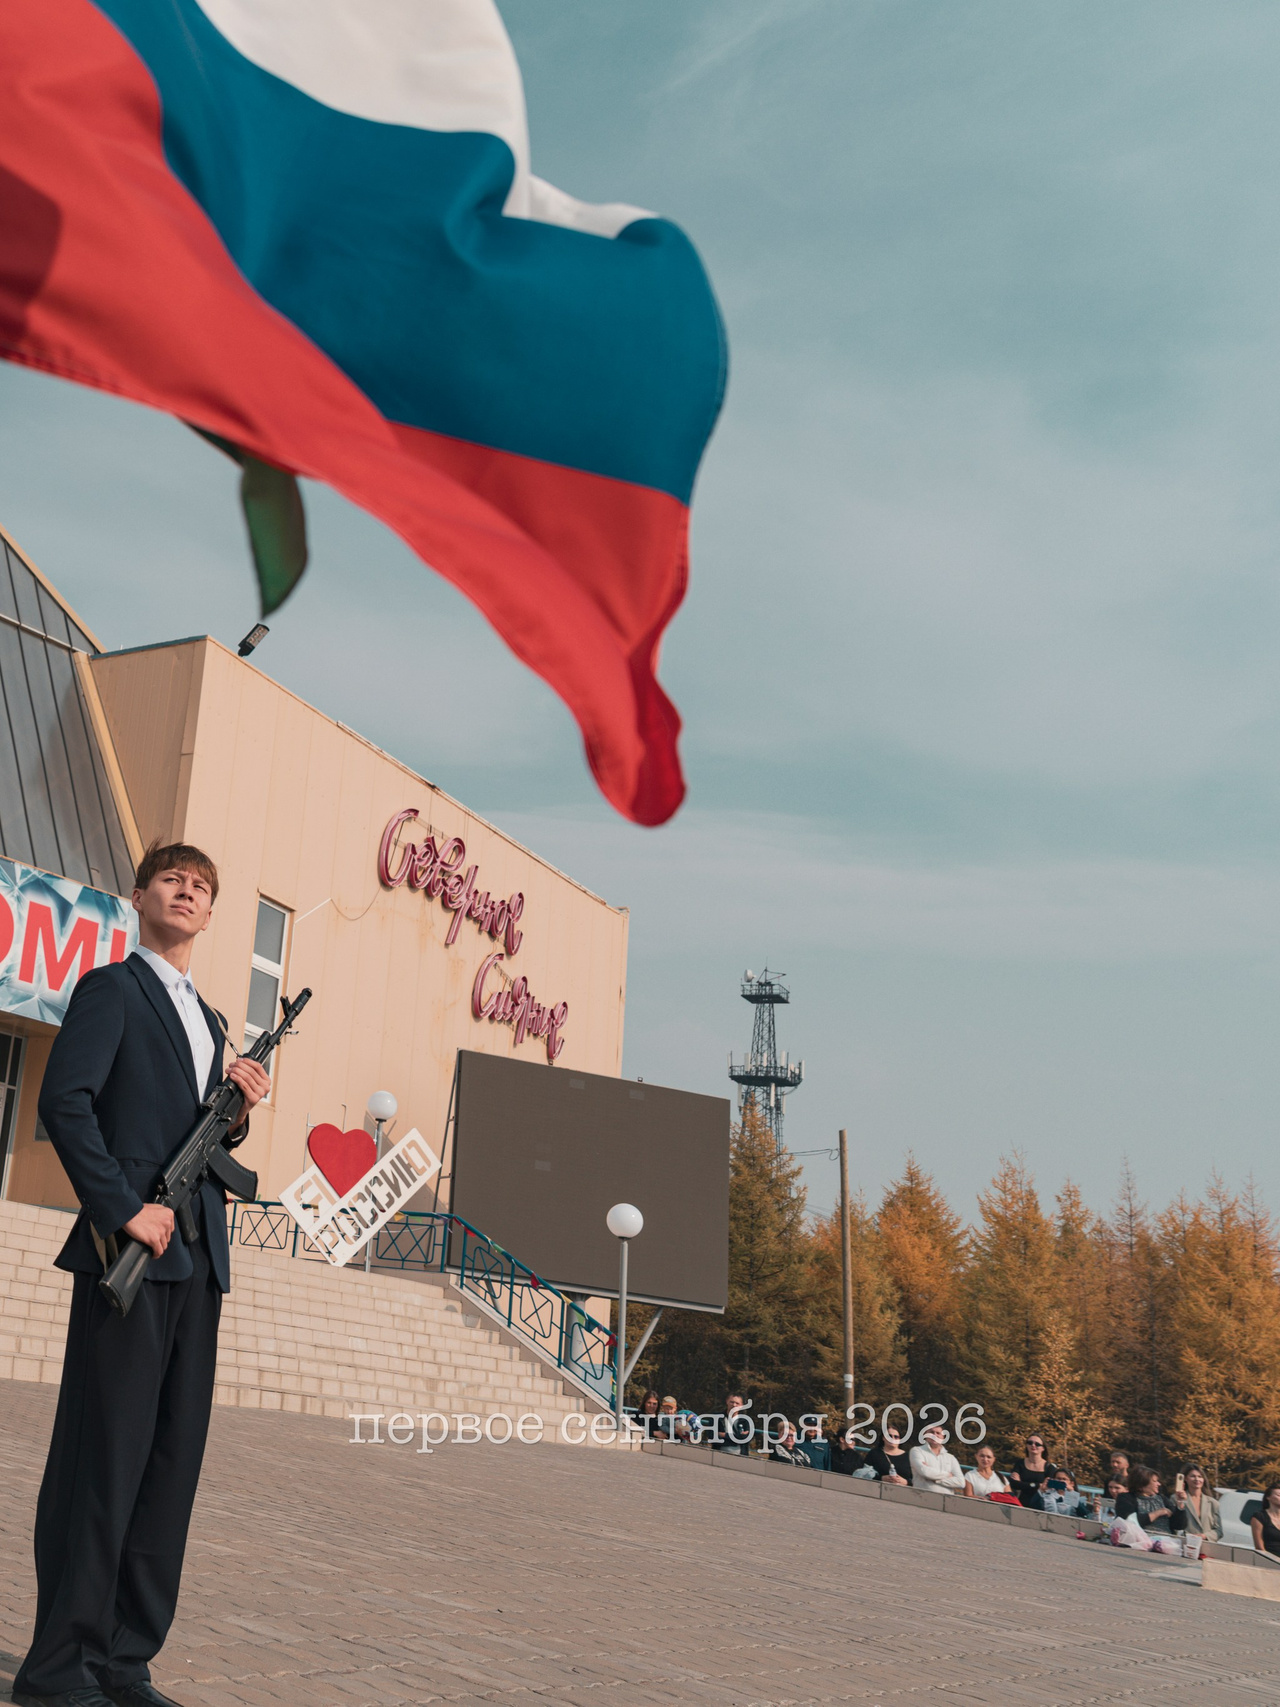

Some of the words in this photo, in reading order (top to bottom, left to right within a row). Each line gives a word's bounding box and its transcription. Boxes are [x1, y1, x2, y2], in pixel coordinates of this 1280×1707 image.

[379, 808, 525, 956] Северное
[294, 1173, 337, 1224] Я
[312, 1139, 432, 1263] РОССИЮ
